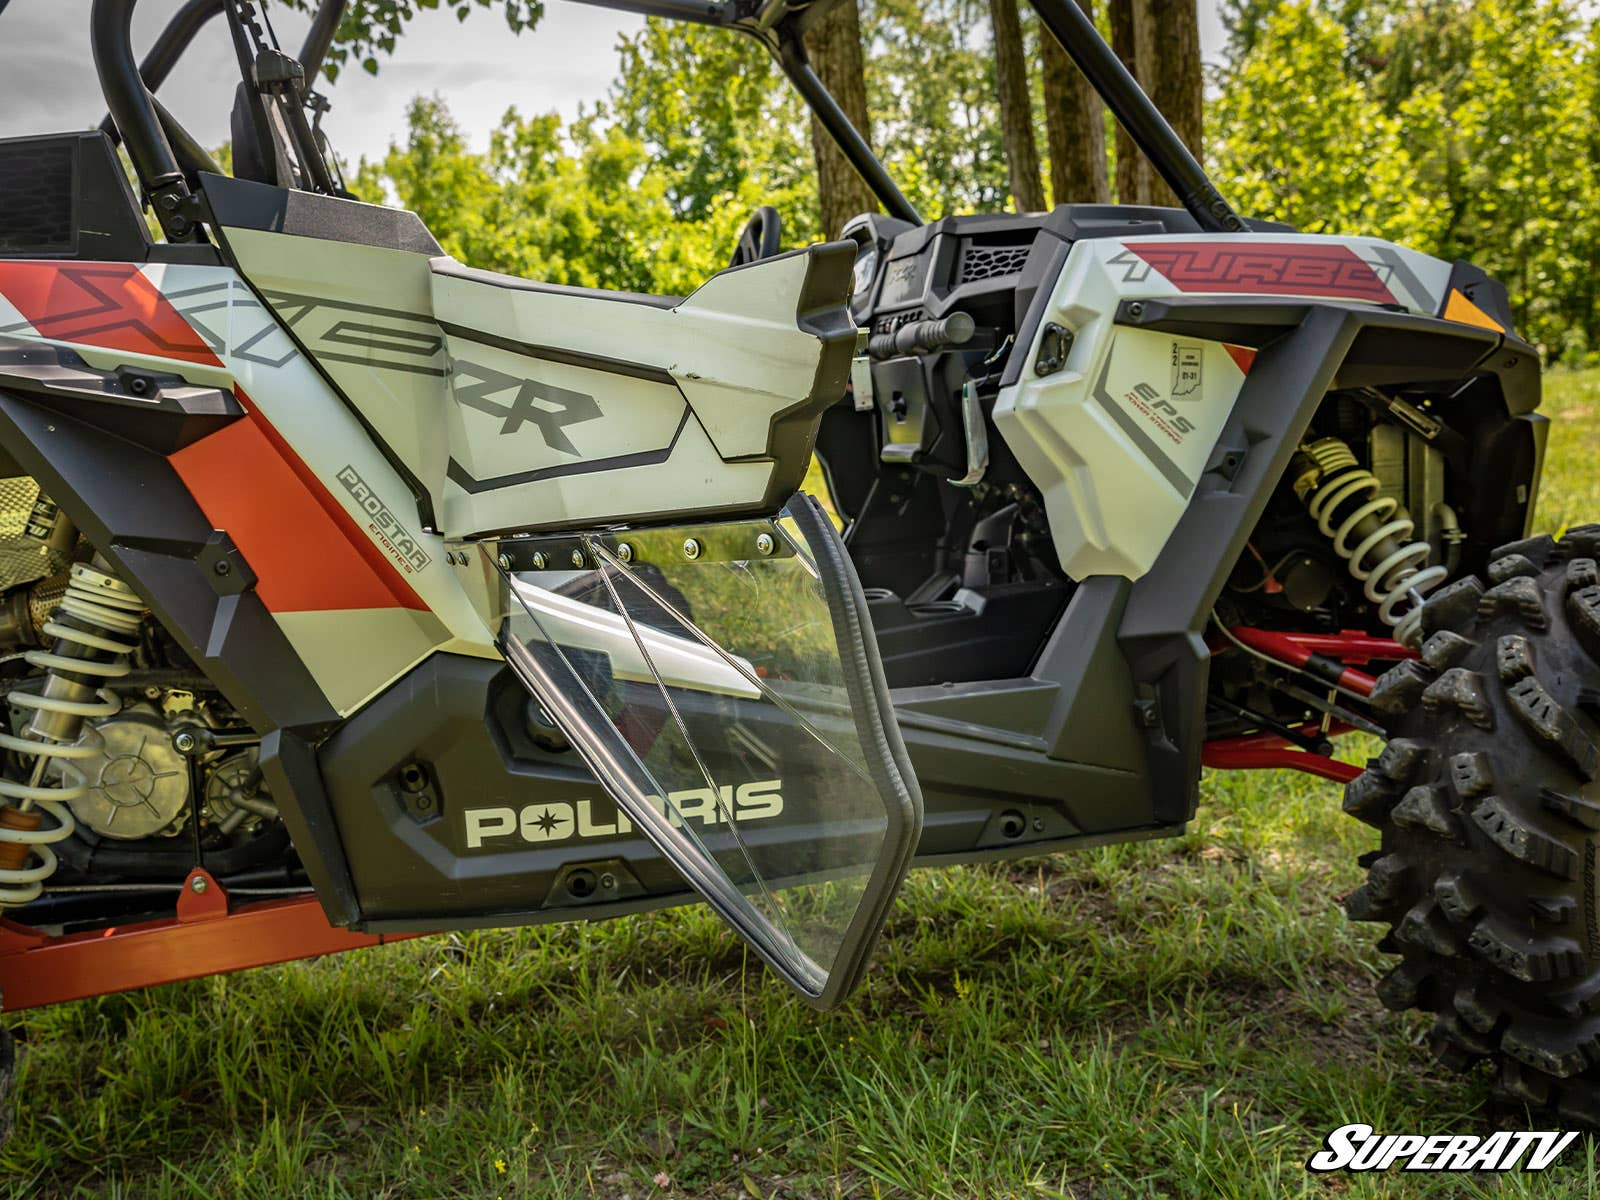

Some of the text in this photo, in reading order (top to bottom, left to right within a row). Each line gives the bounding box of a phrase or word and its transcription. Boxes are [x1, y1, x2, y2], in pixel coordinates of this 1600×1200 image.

[1106, 249, 1394, 294] TURBO
[1134, 382, 1196, 433] EPS
[338, 466, 429, 570] PROSTAR
